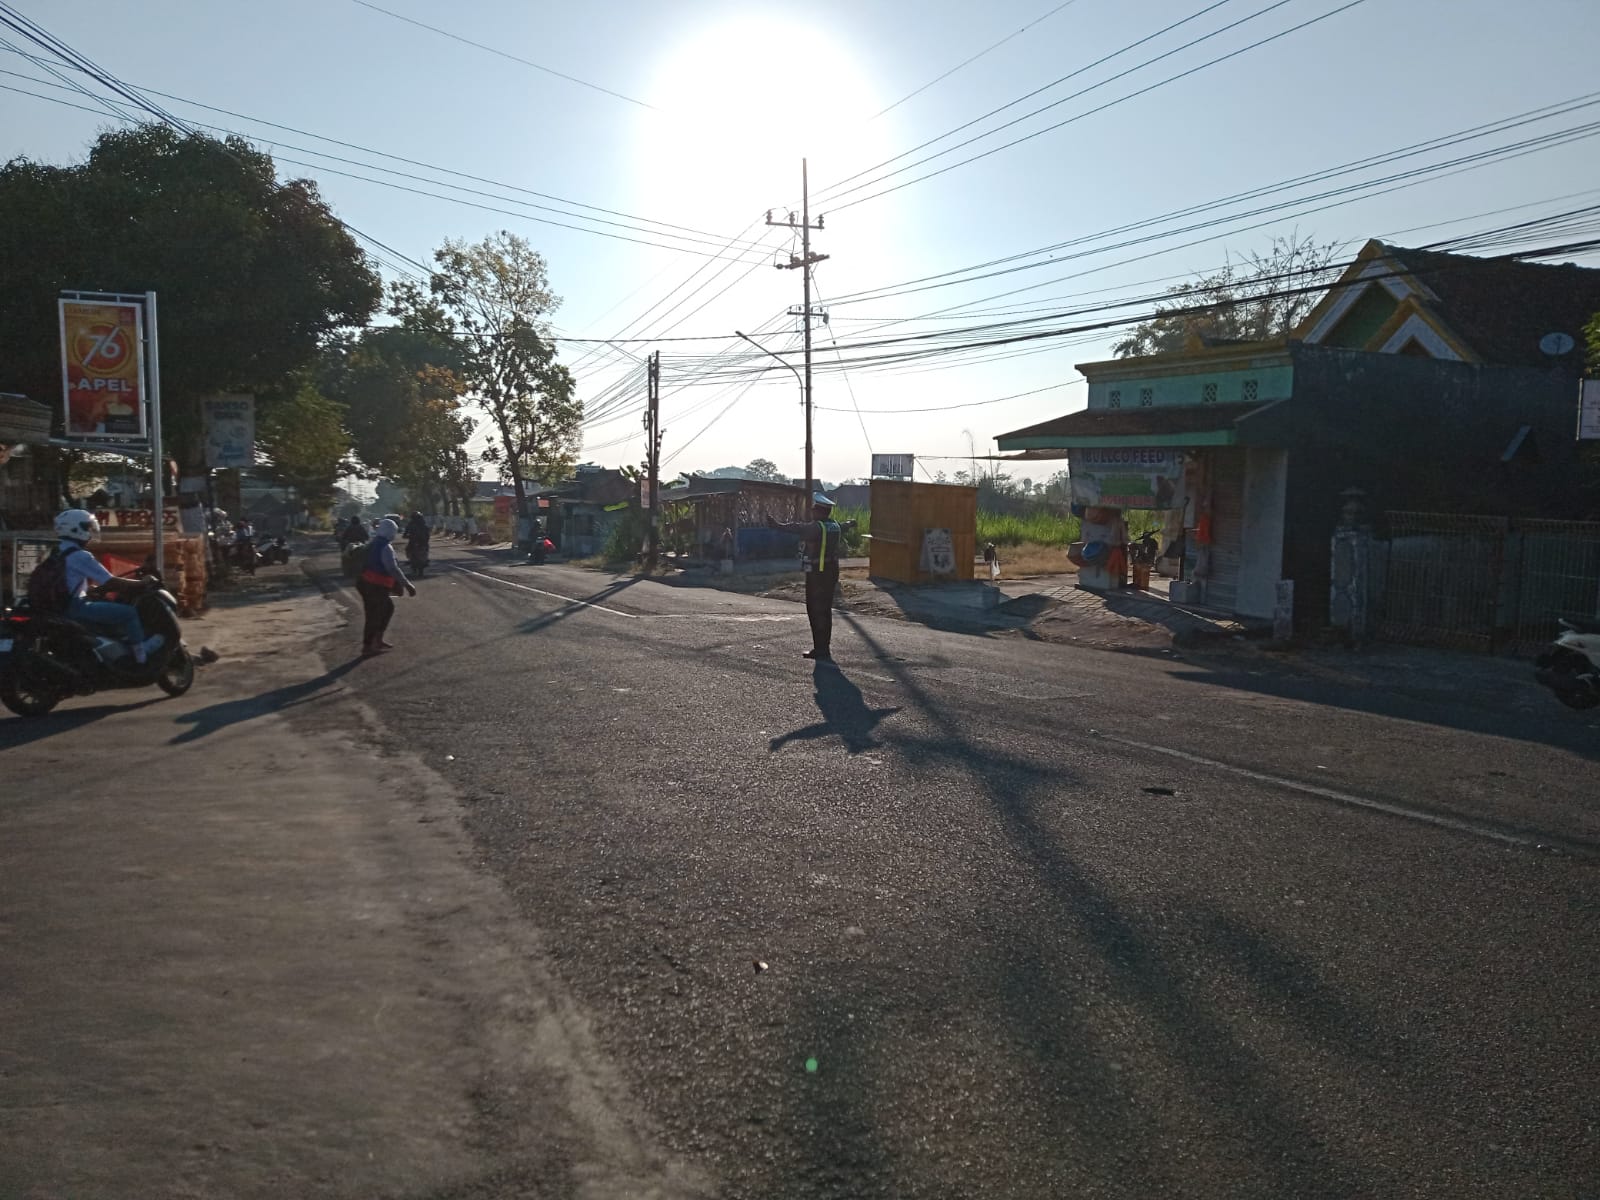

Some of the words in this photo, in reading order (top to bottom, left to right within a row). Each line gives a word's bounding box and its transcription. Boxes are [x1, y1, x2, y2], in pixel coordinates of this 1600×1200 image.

[81, 325, 122, 368] 76
[77, 377, 133, 392] APEL
[1134, 448, 1165, 464] FEED
